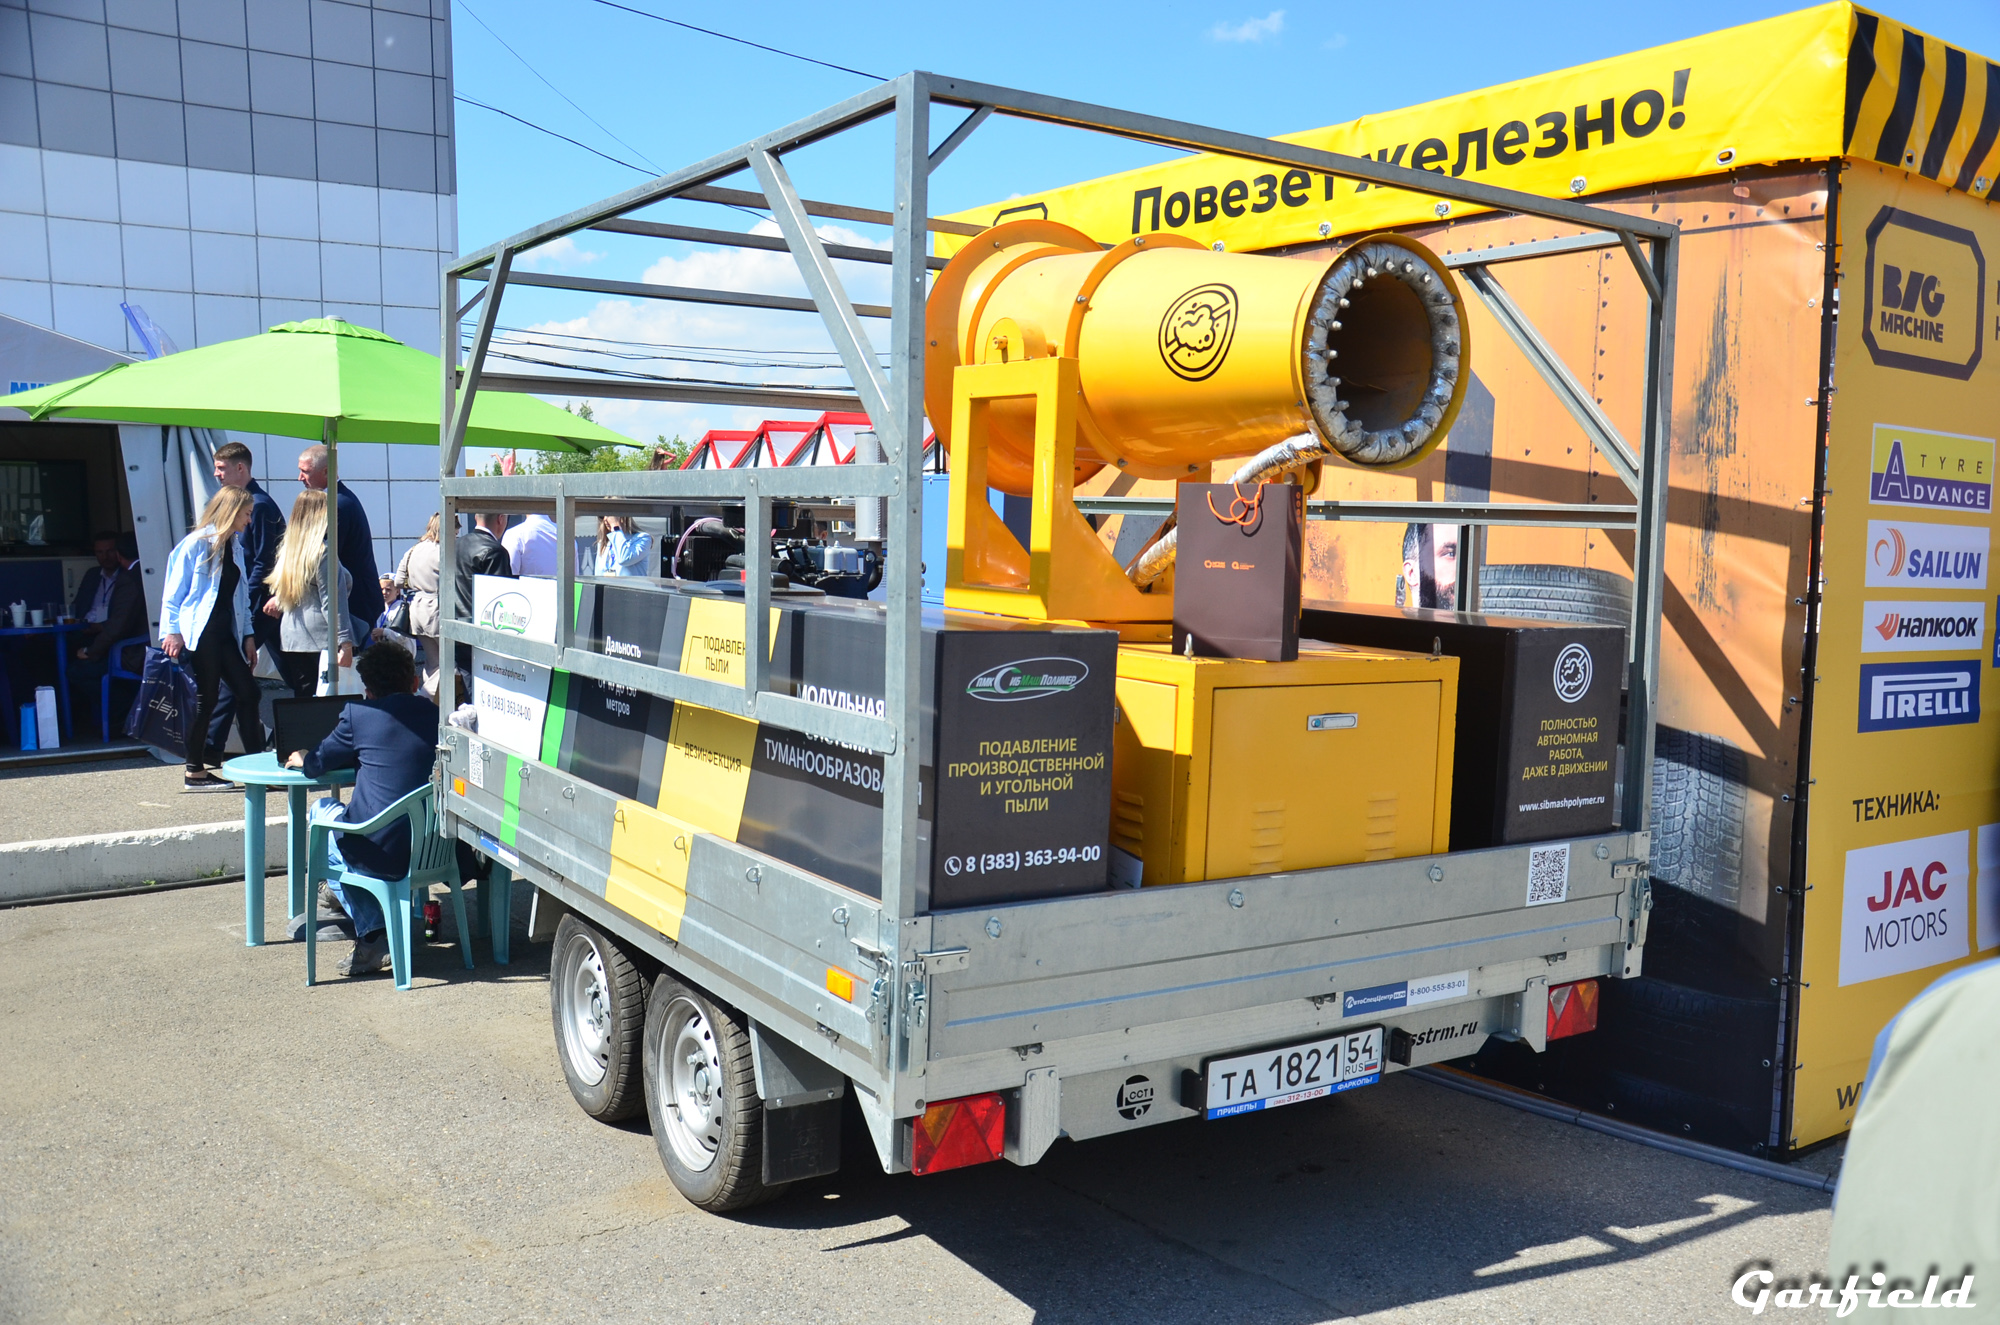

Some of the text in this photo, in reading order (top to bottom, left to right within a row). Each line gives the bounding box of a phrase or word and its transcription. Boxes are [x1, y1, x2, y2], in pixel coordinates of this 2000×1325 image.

[1131, 166, 1335, 234] Повезет
[1882, 264, 1945, 318] BIG
[1880, 311, 1944, 343] MACHINE
[1879, 439, 1986, 507] ADVANCE
[1920, 454, 1983, 474] TYRE
[1907, 549, 1982, 579] SAILUN
[605, 636, 642, 658] Дальность
[705, 656, 729, 675] ПЫЛИ
[976, 677, 995, 688] ПМК
[797, 683, 885, 718] МОДУЛЬНАЯ
[1870, 671, 1971, 720] PIRELLI
[605, 697, 631, 717] метров
[1540, 717, 1598, 731] ПОЛНОСТЬЮ
[979, 738, 1077, 758] ПОДАВЛЕНИЕ
[1537, 732, 1598, 747] АВТОНОМНАЯ
[684, 742, 742, 773] ДЕЗИНФЕКЦИЯ
[948, 753, 1105, 777] ПРОИЗВОДСТВЕННОЙ
[1549, 748, 1585, 761] РАБОТА,
[1522, 760, 1608, 781] ДАЖЕ В ДВИЖЕНИИ
[980, 774, 1073, 795] И УГОЛЬНОЙ
[1005, 797, 1049, 814] ПЫЛИ
[1519, 796, 1605, 812] www.sibmashpolymer.ru
[1853, 790, 1940, 822] ТЕХНИКА:
[965, 845, 1100, 874] 8 (383) 363-94-00
[1867, 861, 1948, 912] JAC
[1865, 908, 1947, 953] MOTORS
[1410, 980, 1467, 996] 8-800-555-83-01
[1268, 1043, 1338, 1091] 1821
[1347, 1034, 1374, 1064] 54
[1345, 1062, 1364, 1077] RUS
[1337, 1076, 1374, 1091] ФАРКОПЫ
[1287, 1088, 1324, 1103] 312-13-00
[1216, 1102, 1258, 1117] ПРИЦЕПЫ
